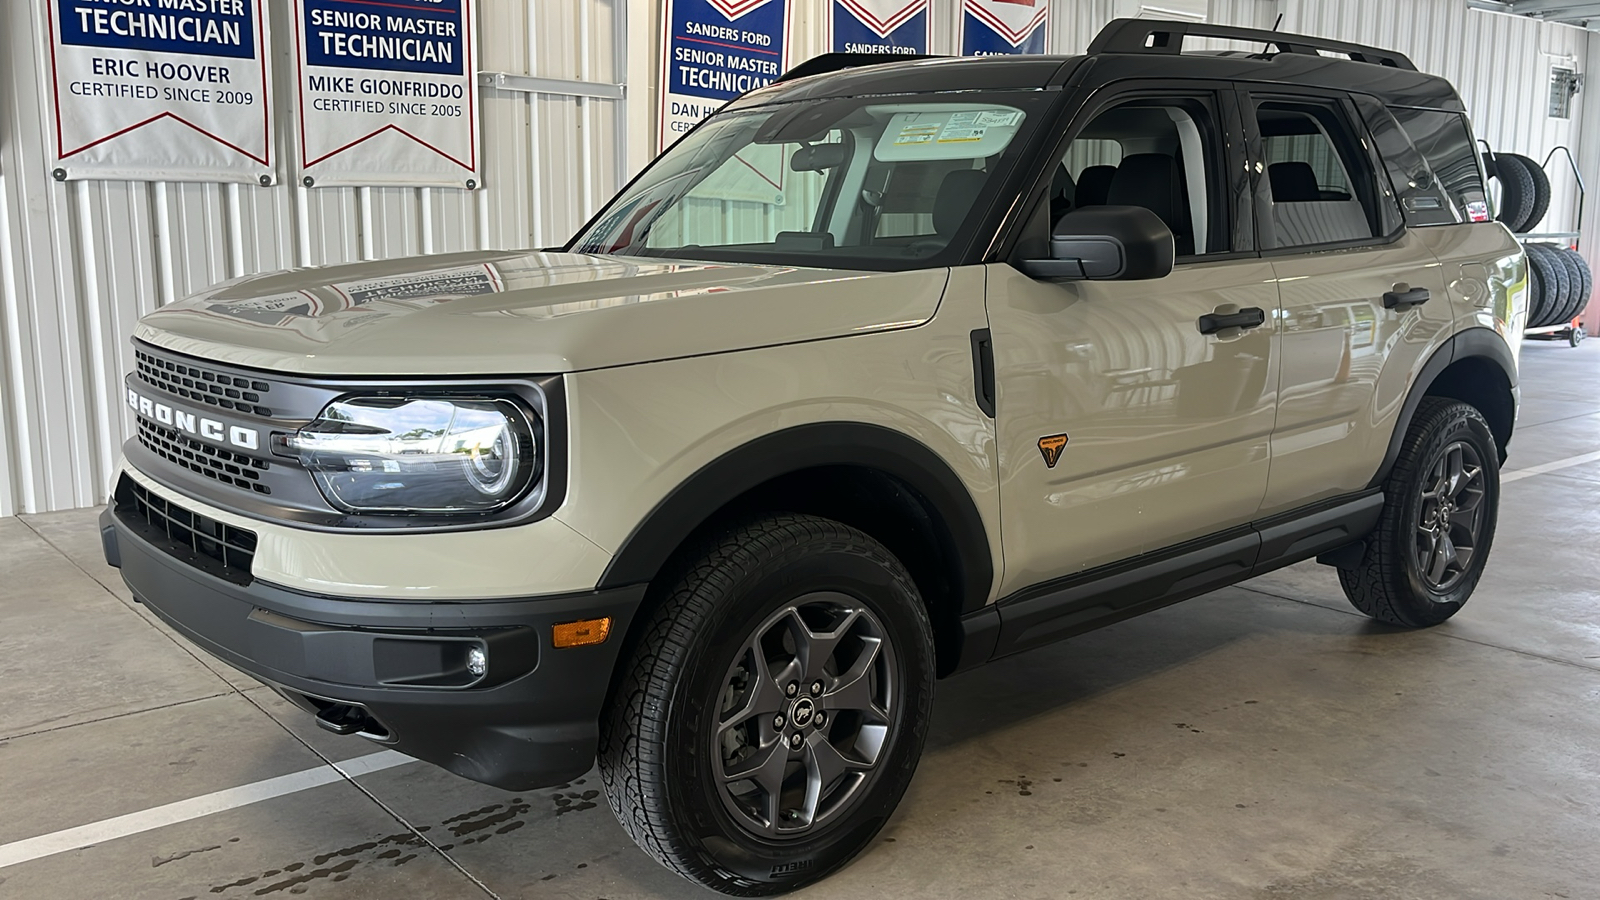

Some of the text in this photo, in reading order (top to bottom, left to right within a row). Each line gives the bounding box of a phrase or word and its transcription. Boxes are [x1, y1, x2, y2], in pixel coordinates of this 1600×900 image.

[158, 0, 245, 16] MASTER
[74, 7, 241, 46] TECHNICIAN
[311, 9, 456, 37] SENIOR MASTER
[686, 21, 771, 47] SANDERS FORD
[318, 31, 452, 64] TECHNICIAN
[844, 42, 917, 54] SANDERS FORD
[92, 57, 231, 84] ERIC HOOVER
[675, 47, 778, 76] SENIOR MASTER
[69, 81, 254, 105] CERTIFIED SINCE 2009
[308, 75, 463, 99] MIKE GIONFRIDDO
[313, 98, 462, 117] CERTIFIED SINCE 2005
[671, 102, 699, 118] DAN
[127, 388, 259, 450] BRONCO
